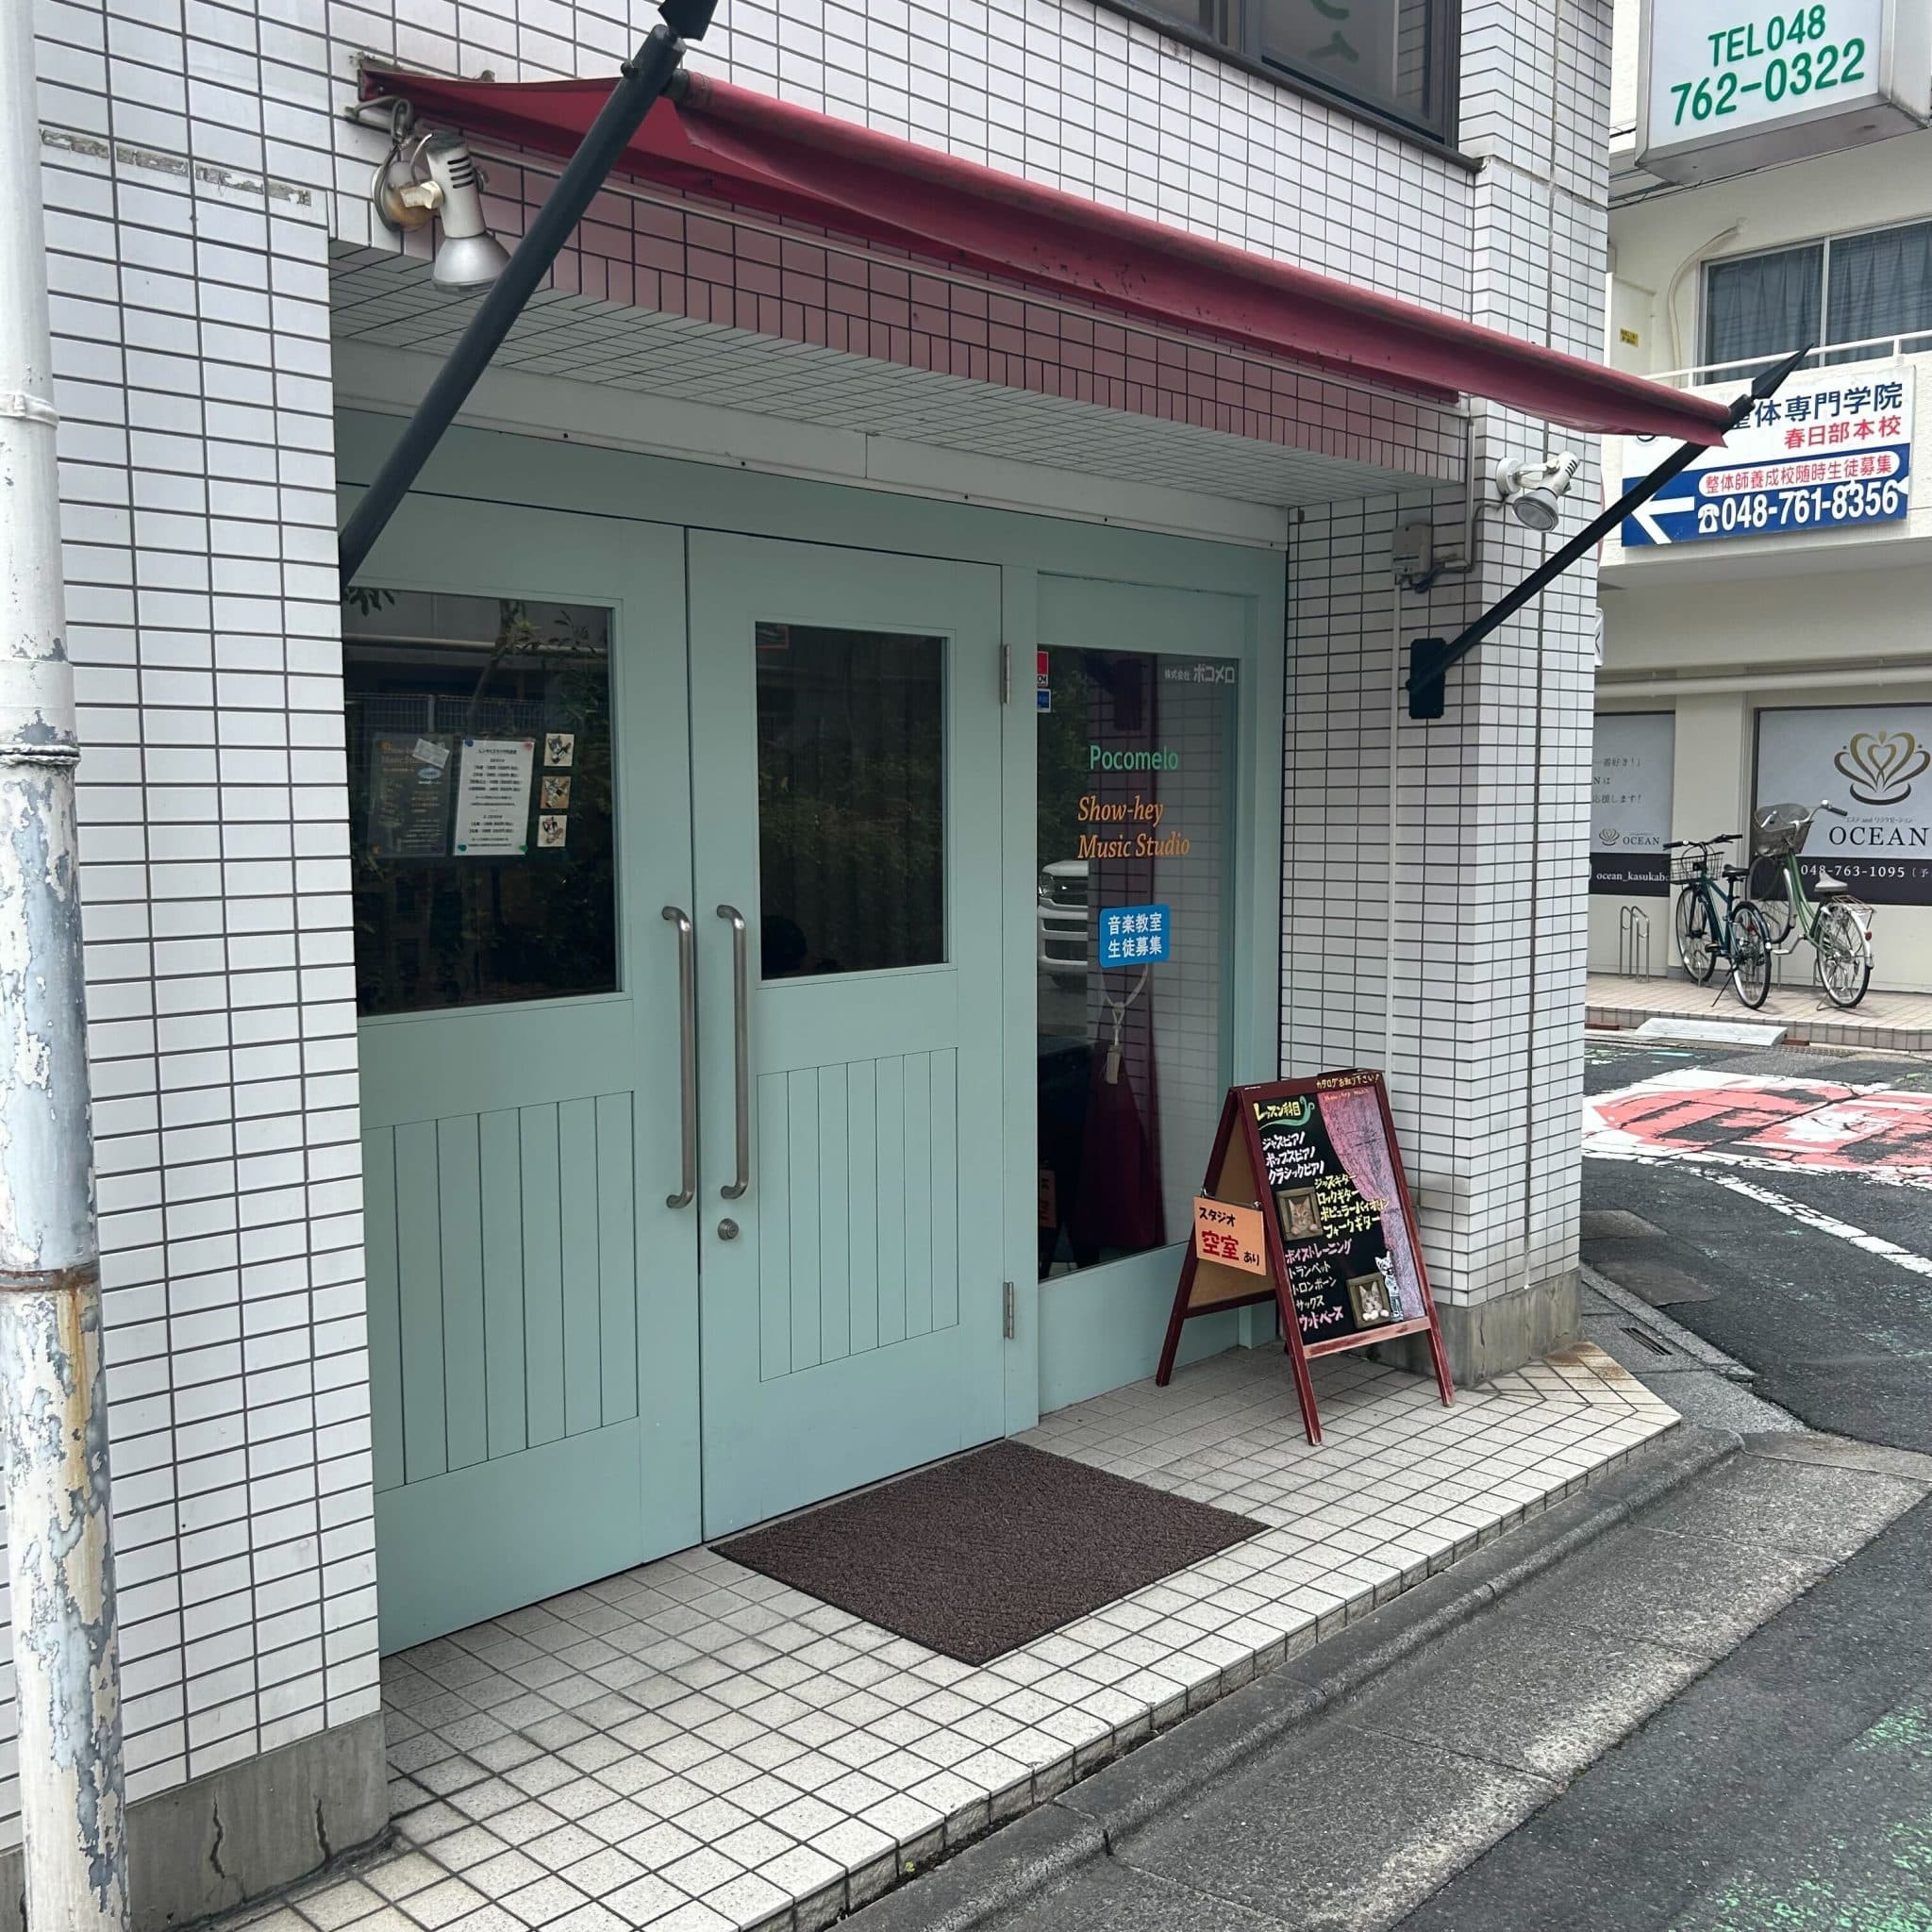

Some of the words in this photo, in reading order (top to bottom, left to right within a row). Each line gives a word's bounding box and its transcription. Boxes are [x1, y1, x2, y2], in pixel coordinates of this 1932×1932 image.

[1671, 38, 1865, 126] 762-0322
[1785, 415, 1903, 450] 春日部本校
[1706, 454, 1892, 494] 整体師養成校随時生徒募集
[1723, 479, 1899, 532] 048-761-8356
[1193, 664, 1236, 684] ポコメロ
[1090, 745, 1179, 772] Pocomelo
[1077, 794, 1164, 828] Show-hey
[1077, 835, 1131, 859] Music
[1136, 831, 1191, 858] Studio
[1623, 836, 1660, 846] OCEAN
[1829, 826, 1930, 846] OCEAN
[1108, 911, 1162, 936] 音楽教室
[1108, 935, 1162, 959] 生徒募集
[1253, 1100, 1301, 1121] レッスン科目
[1199, 1207, 1236, 1227] スタジオ
[1202, 1230, 1240, 1261] 空室
[1243, 1251, 1260, 1267] あり
[1296, 1294, 1324, 1311] サックス
